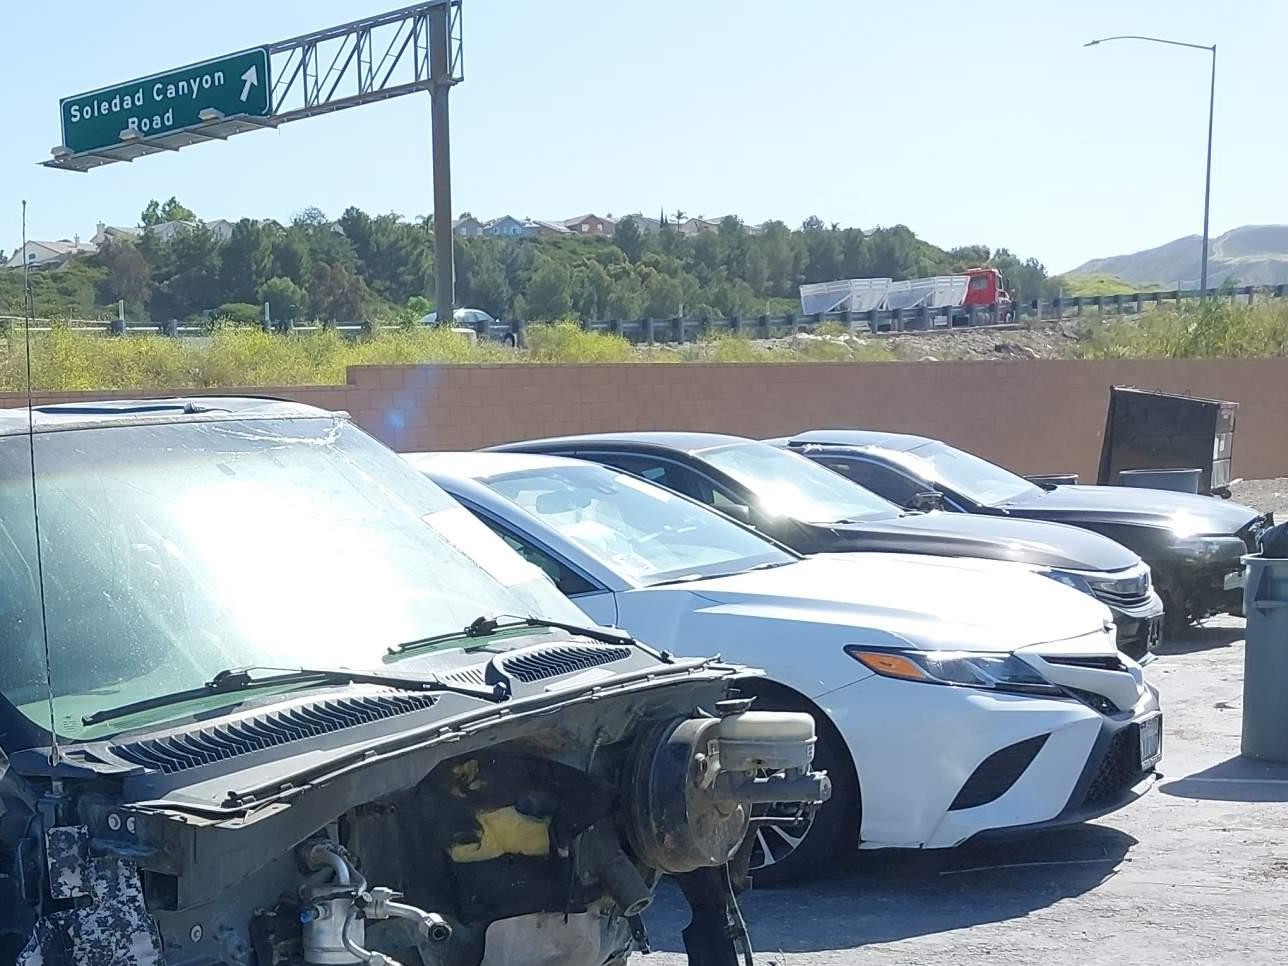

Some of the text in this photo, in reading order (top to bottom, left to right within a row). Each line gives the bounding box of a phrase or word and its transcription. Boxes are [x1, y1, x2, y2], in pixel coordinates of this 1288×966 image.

[70, 71, 225, 122] Soledad Canyon
[127, 108, 174, 132] Road
